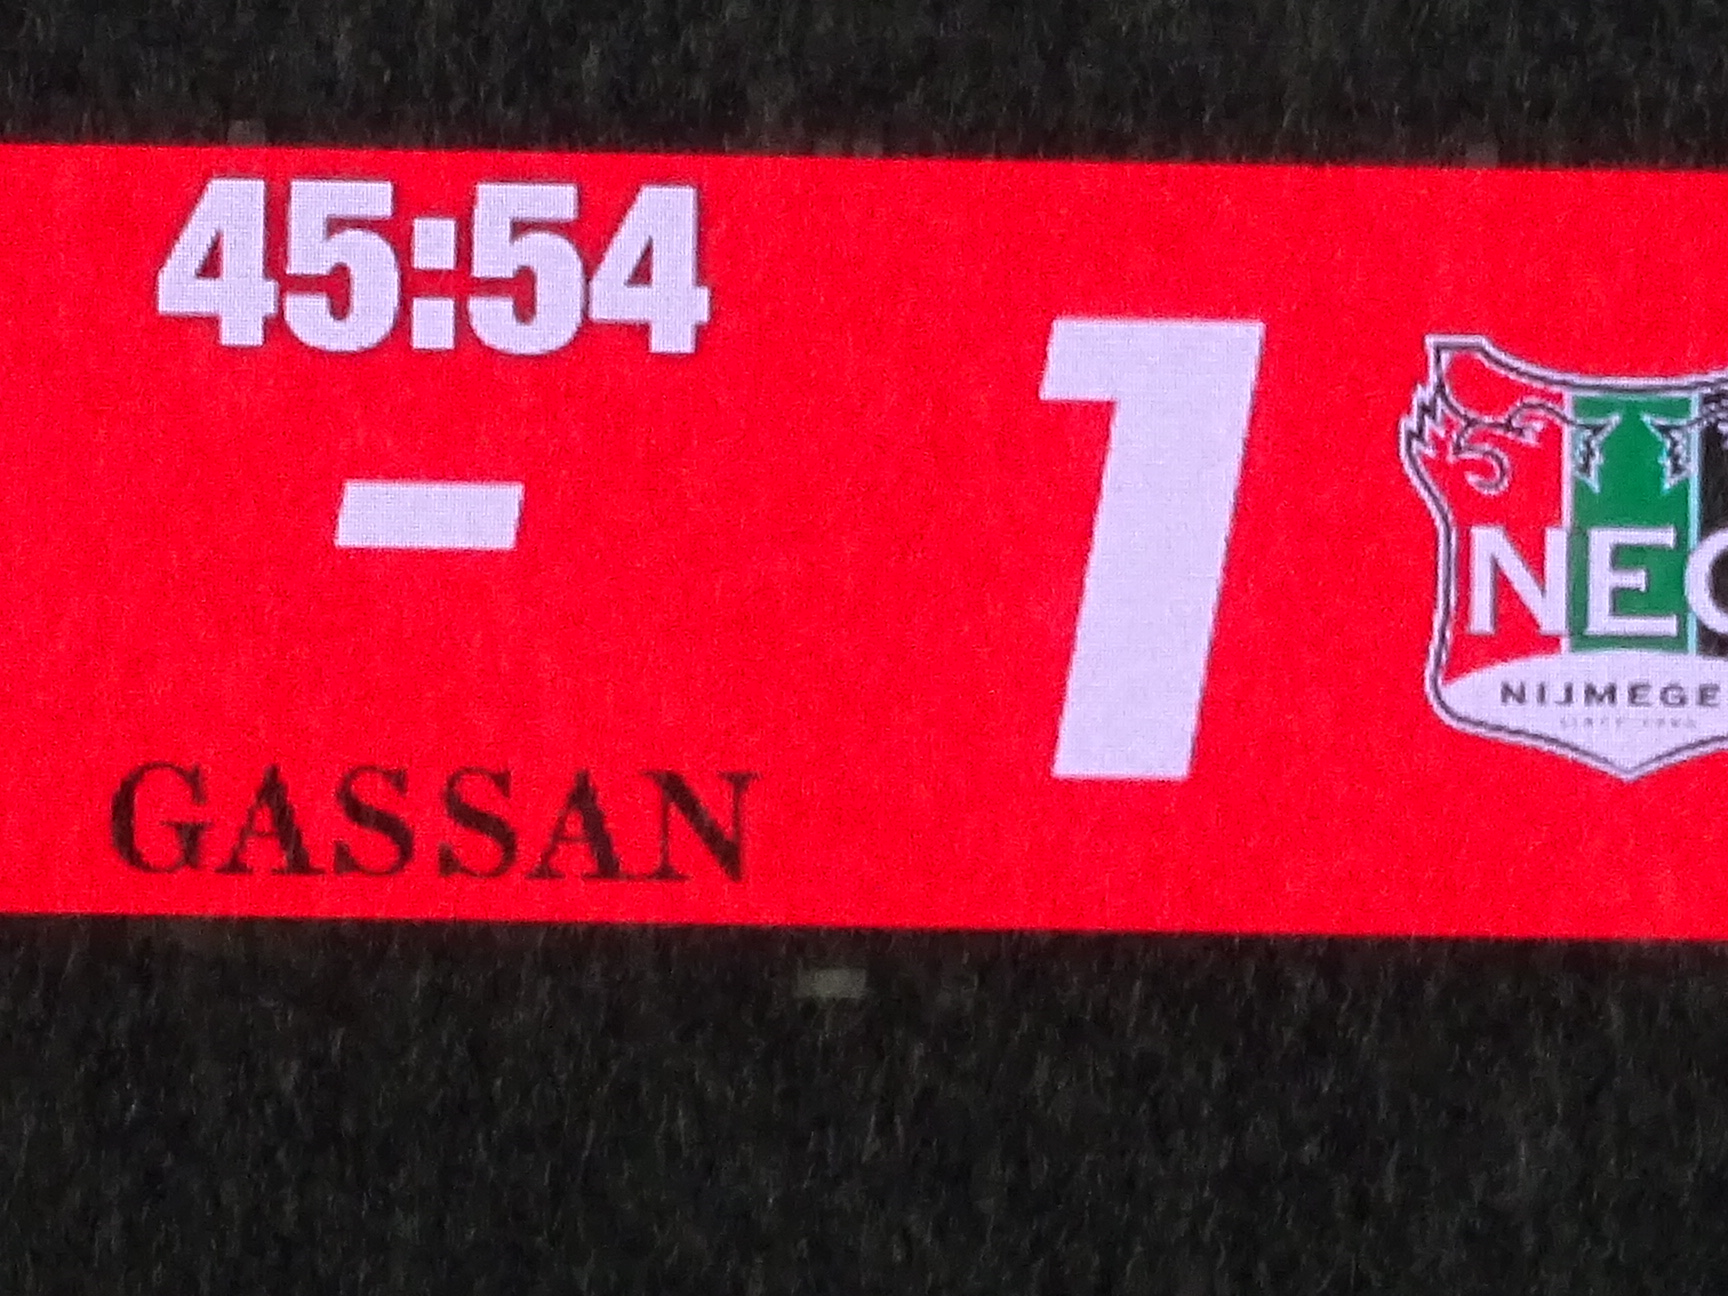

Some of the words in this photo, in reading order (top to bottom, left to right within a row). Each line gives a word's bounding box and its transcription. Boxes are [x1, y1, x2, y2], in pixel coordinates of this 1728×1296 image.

[154, 174, 712, 356] 45:54
[1038, 316, 1266, 781] 1
[109, 759, 762, 884] GASSAN
